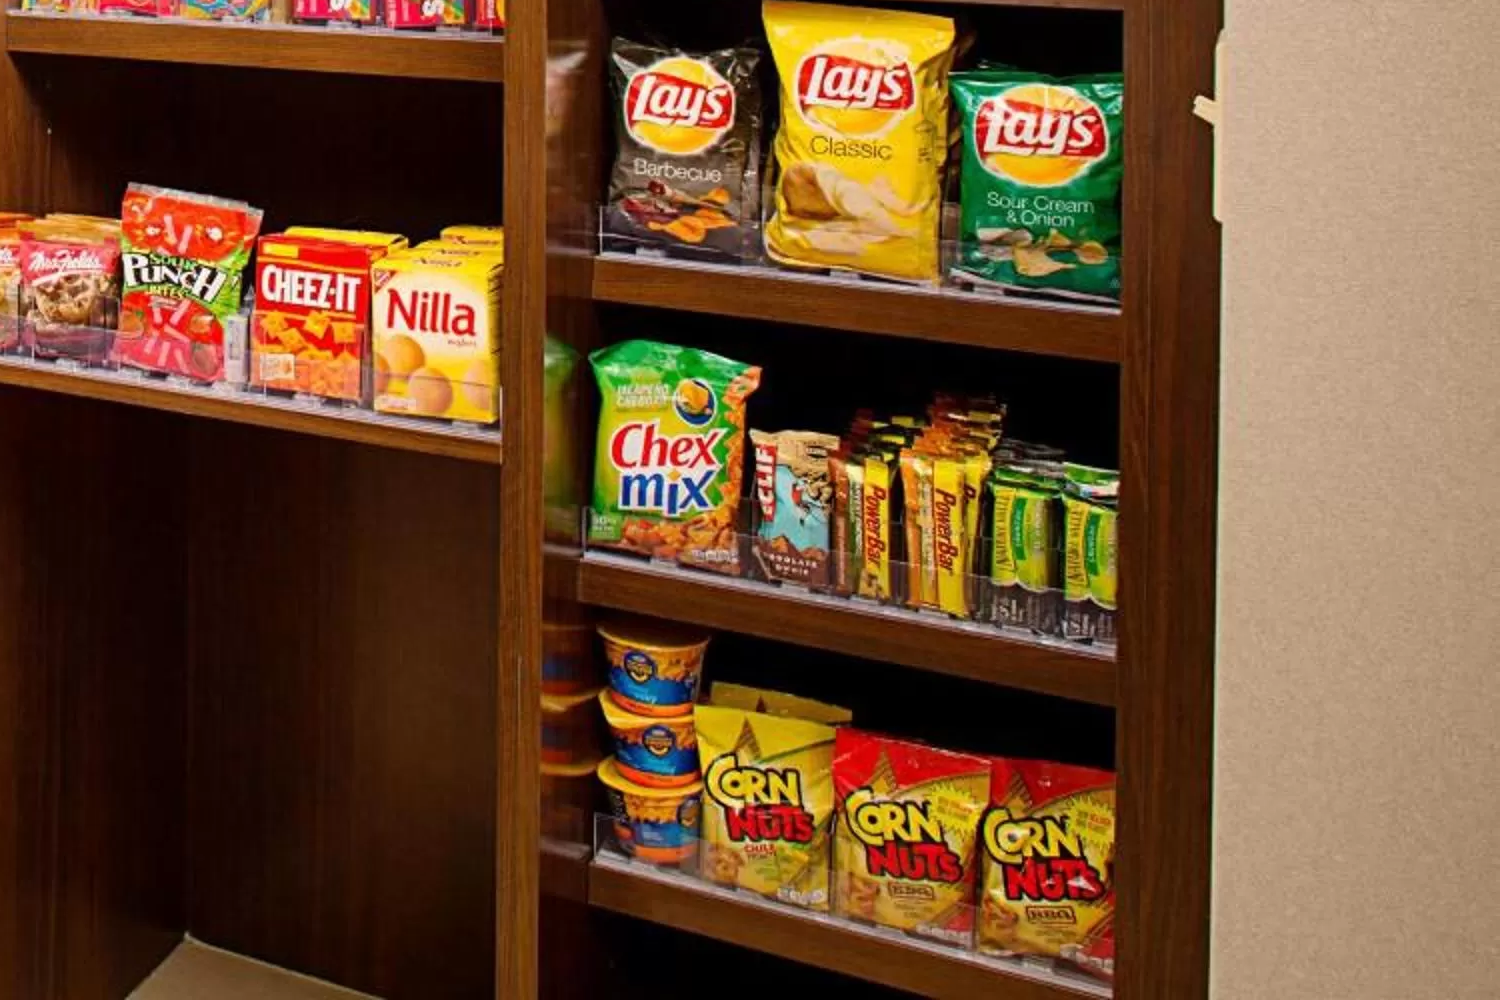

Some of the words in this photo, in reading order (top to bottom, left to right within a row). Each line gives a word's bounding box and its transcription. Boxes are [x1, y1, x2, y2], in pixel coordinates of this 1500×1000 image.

[631, 75, 727, 127] Lay's
[803, 56, 907, 109] Lay's
[810, 135, 893, 161] Classic
[983, 98, 1097, 156] Lay's
[633, 158, 722, 183] Barbecue
[987, 191, 1029, 210] Sour
[1033, 195, 1095, 214] Cream
[1006, 210, 1017, 224] &
[1020, 209, 1075, 227] Onion
[123, 253, 227, 303] PUNCH
[150, 254, 197, 271] SOUR
[261, 263, 361, 312] CHEEZ-IT
[387, 287, 476, 337] Nilla
[612, 422, 723, 469] Chex
[864, 484, 887, 570] PowerBar
[935, 487, 959, 577] PowerBar
[707, 754, 801, 811] CORN
[727, 806, 814, 842] NUTS
[846, 788, 943, 847] CORN
[984, 807, 1082, 864] CORN
[866, 843, 963, 882] NUTS
[1006, 858, 1105, 901] NUTS
